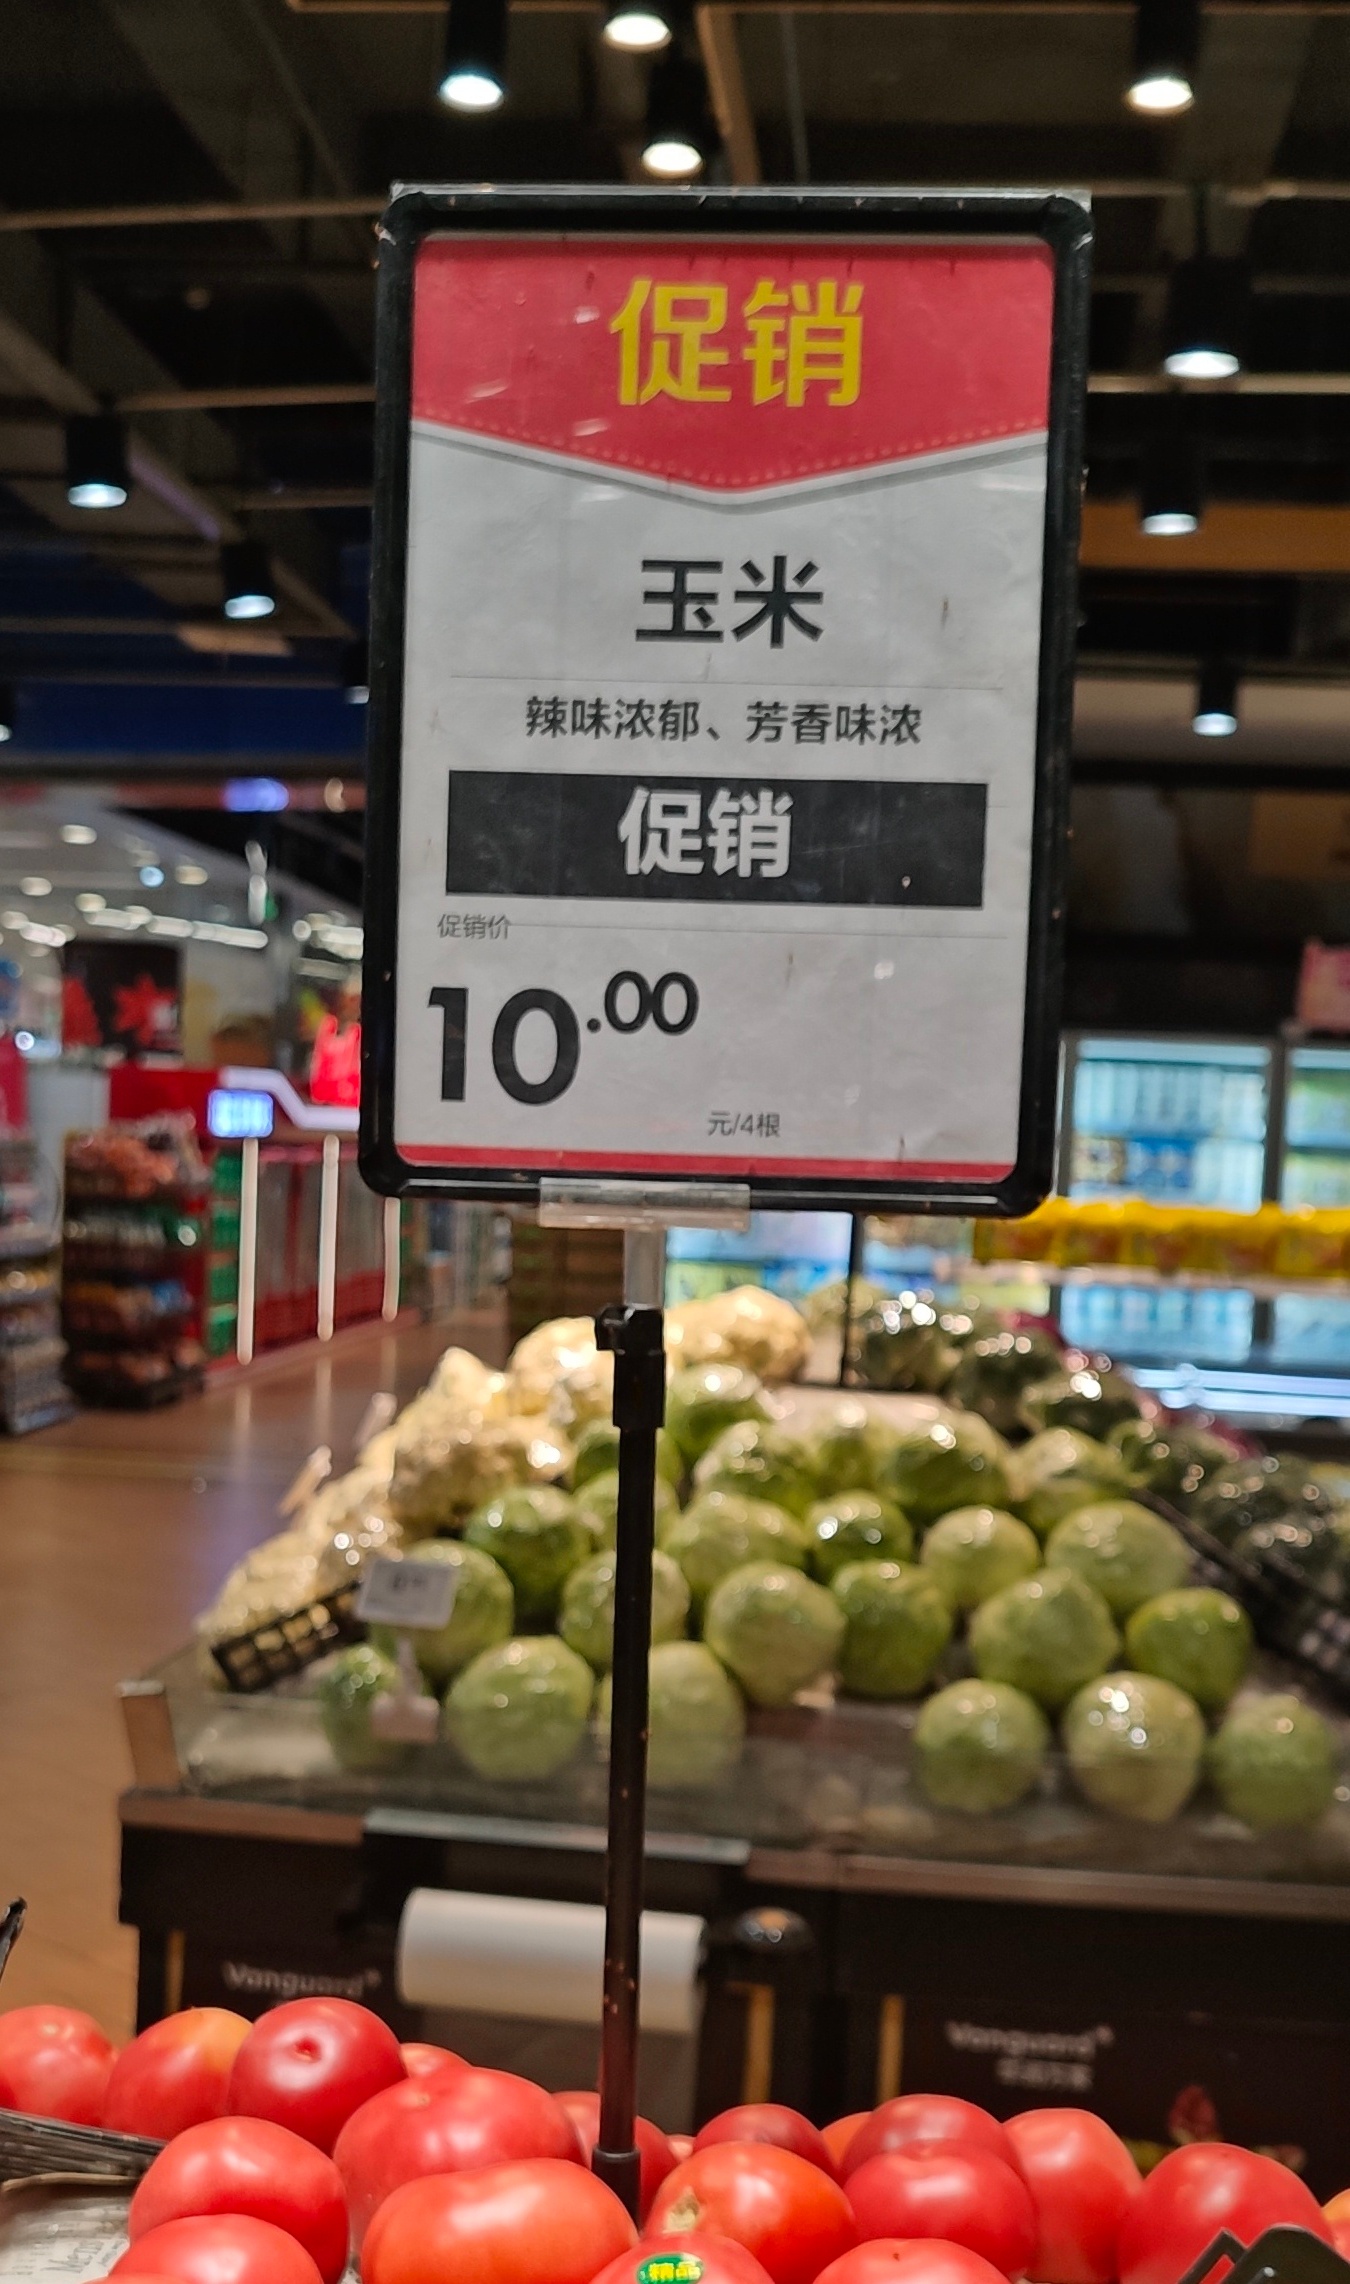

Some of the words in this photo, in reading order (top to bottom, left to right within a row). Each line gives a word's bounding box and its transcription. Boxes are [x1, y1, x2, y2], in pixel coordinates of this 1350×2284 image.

[609, 279, 863, 406] 促销
[635, 555, 824, 648] 玉米
[526, 696, 922, 745] 辣味浓郁、芳香味浓
[617, 785, 793, 878] 促销
[437, 914, 511, 940] 促销价
[428, 970, 699, 1106] 10.00
[707, 1110, 781, 1139] 元/4根
